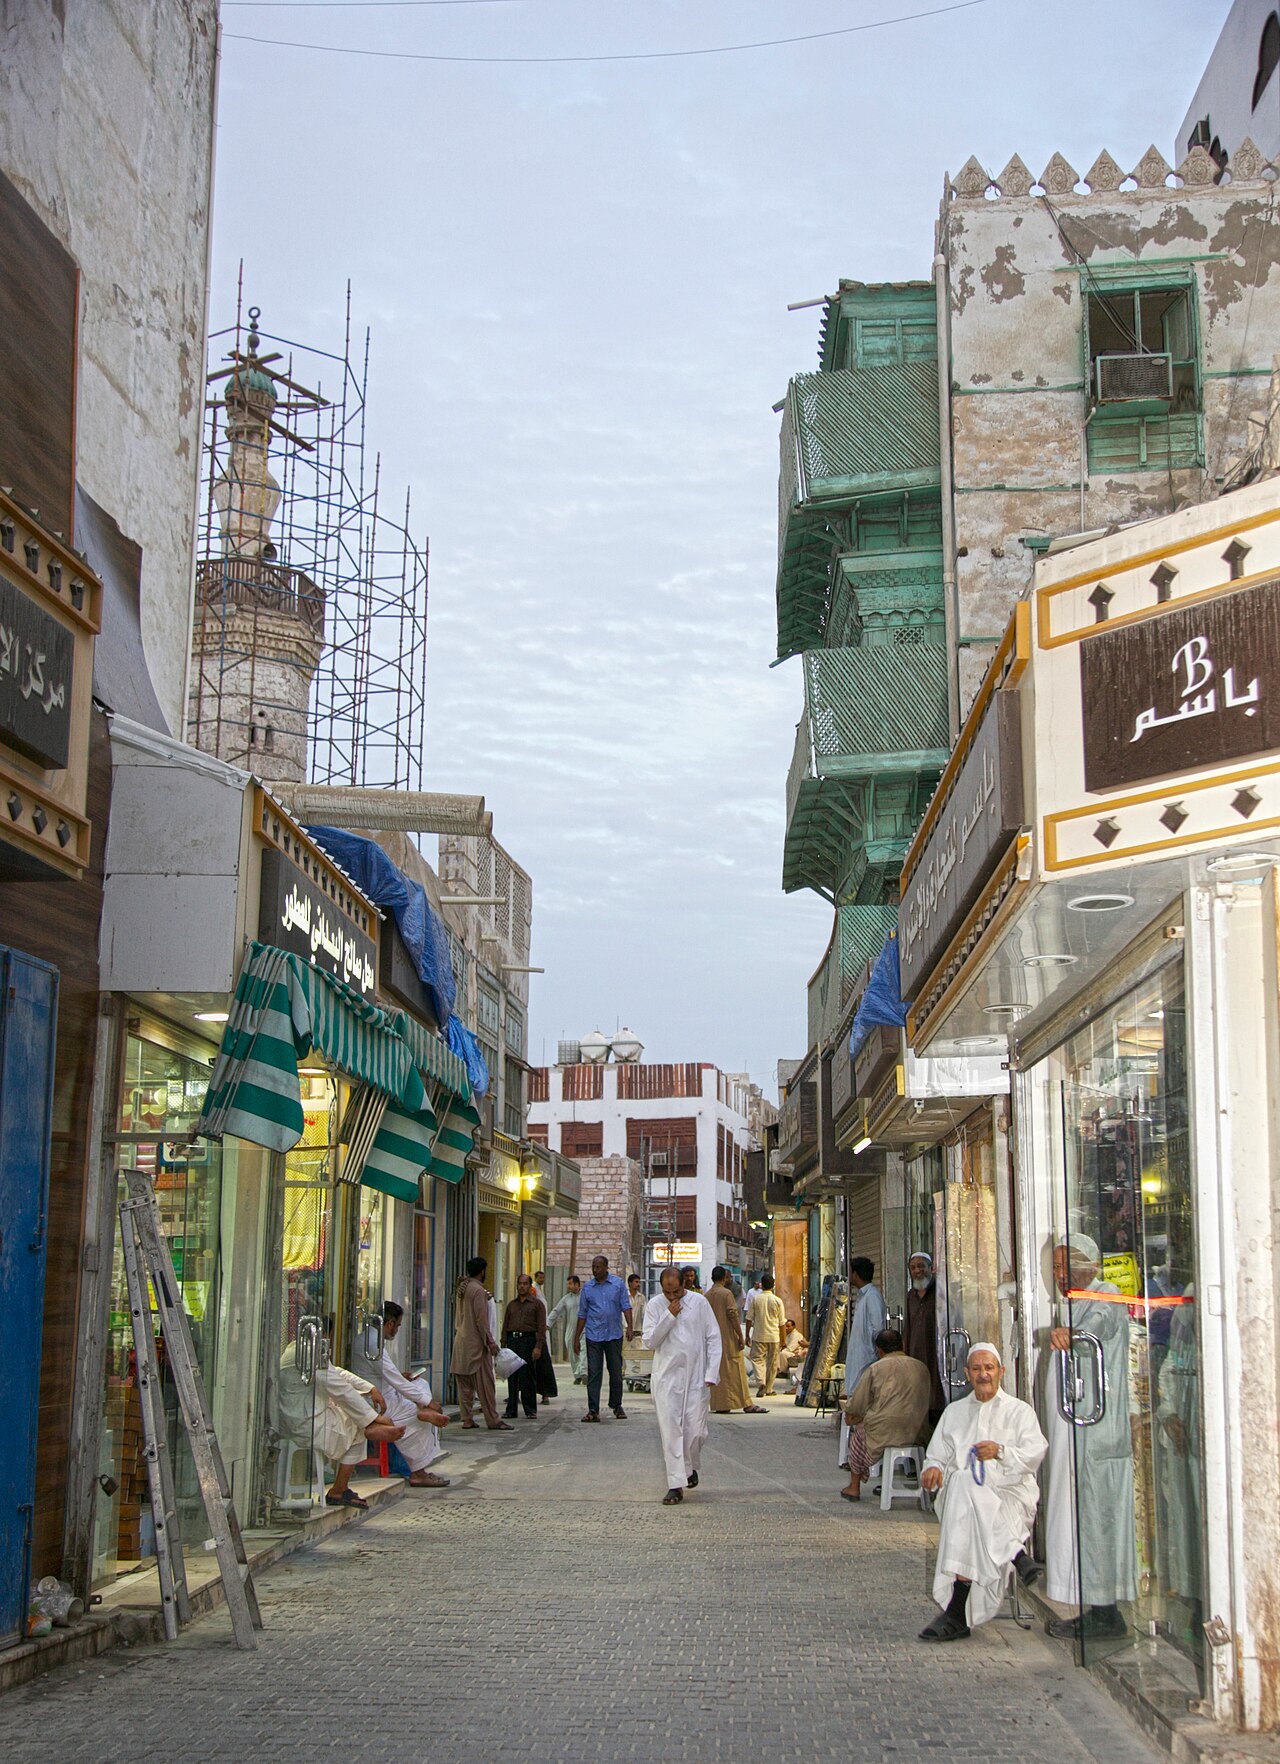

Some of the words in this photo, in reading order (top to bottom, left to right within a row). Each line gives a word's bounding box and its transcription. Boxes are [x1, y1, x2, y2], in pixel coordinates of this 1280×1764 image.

[20, 643, 65, 715] مركز
[1171, 636, 1215, 698] B
[1130, 666, 1261, 743] باسم
[959, 747, 995, 864] باسم
[343, 938, 362, 984] صالح
